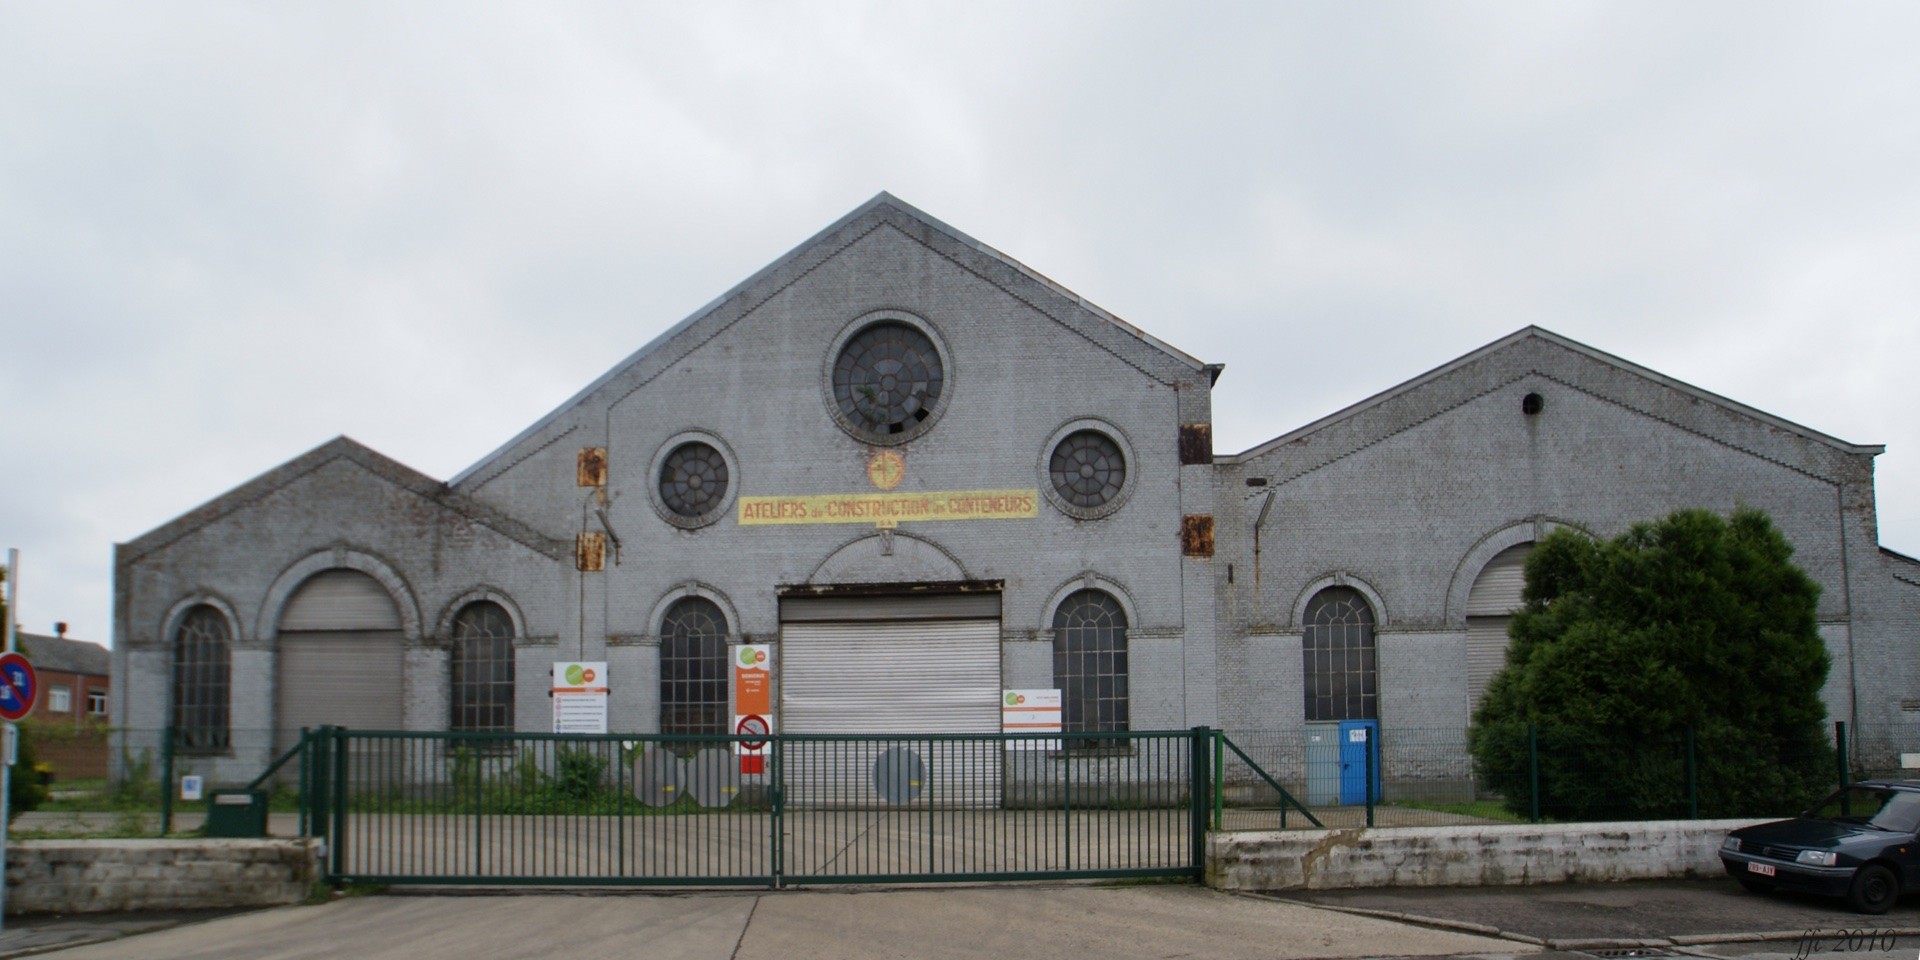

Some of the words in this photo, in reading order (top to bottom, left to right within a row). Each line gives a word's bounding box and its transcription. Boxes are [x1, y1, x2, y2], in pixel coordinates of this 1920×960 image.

[743, 502, 808, 519] ATELIERS
[811, 507, 823, 518] de
[827, 498, 929, 518] CONSTRUCTION
[949, 496, 1032, 514] CONTENEURS
